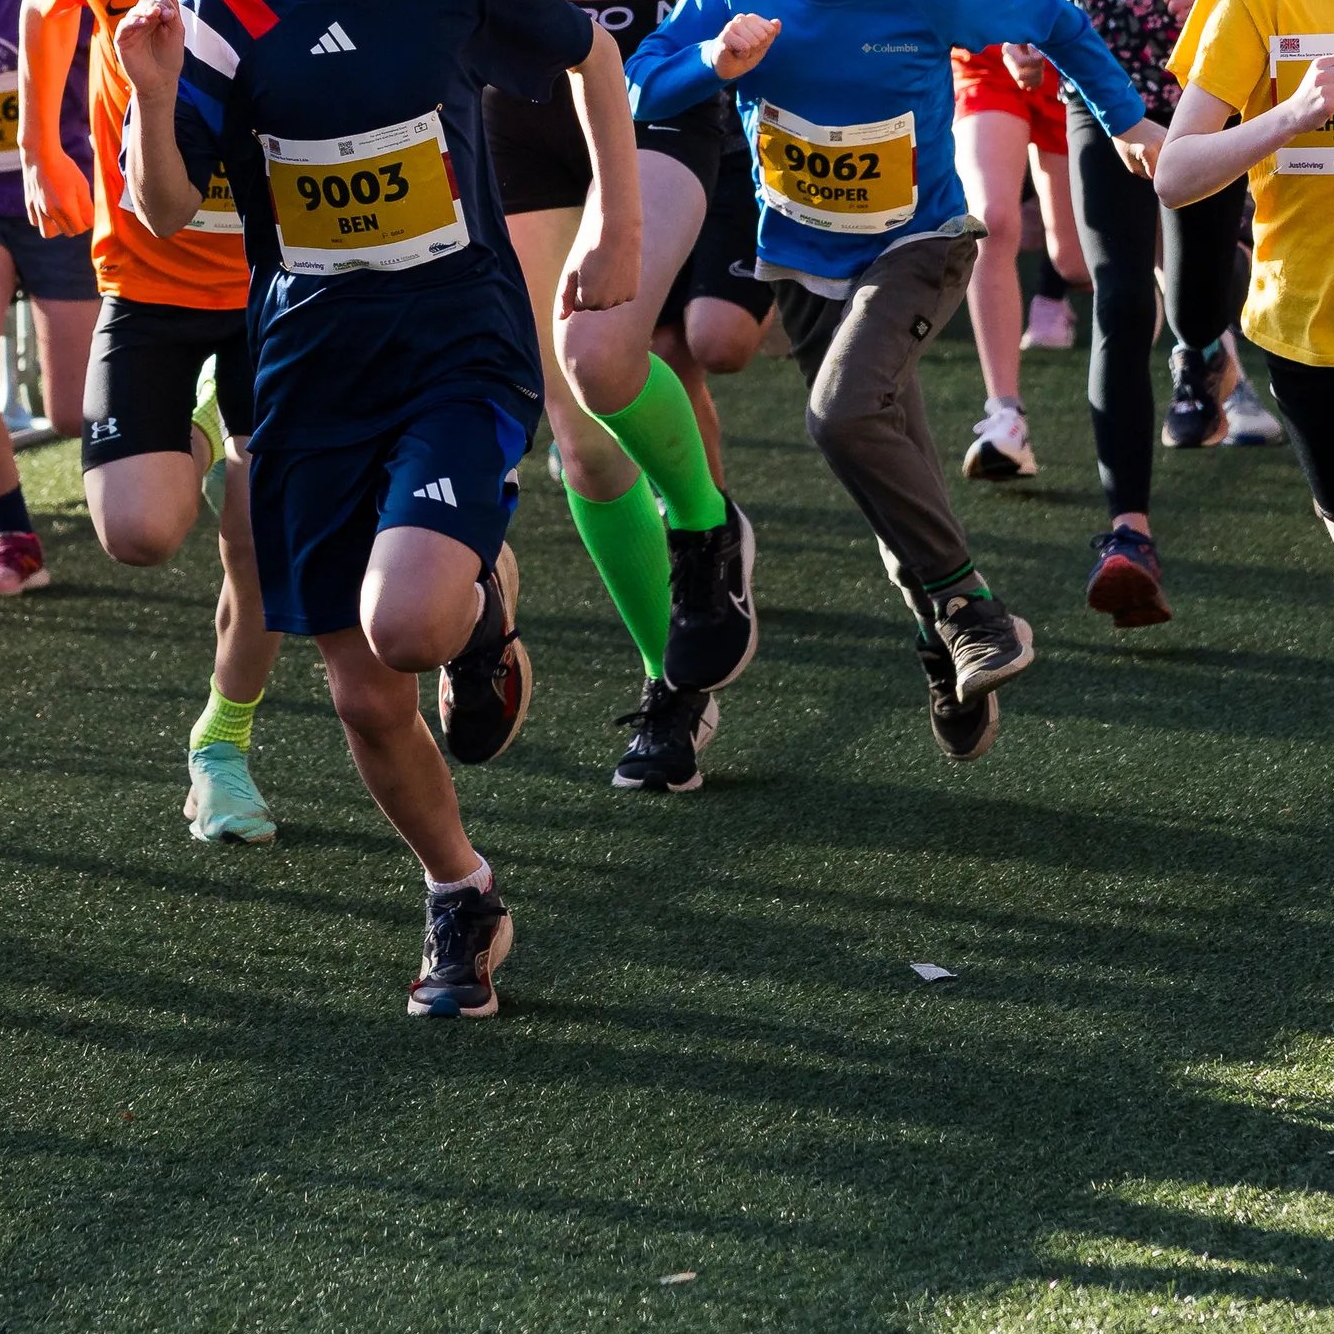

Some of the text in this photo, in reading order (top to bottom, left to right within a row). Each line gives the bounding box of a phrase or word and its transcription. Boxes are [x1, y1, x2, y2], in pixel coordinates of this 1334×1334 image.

[872, 43, 918, 54] Columbia
[784, 144, 881, 181] 9062
[1288, 161, 1324, 170] JustGiving
[296, 162, 409, 211] 9003
[796, 179, 869, 201] COOPER
[337, 214, 379, 235] BEN
[293, 260, 324, 270] JustGiving
